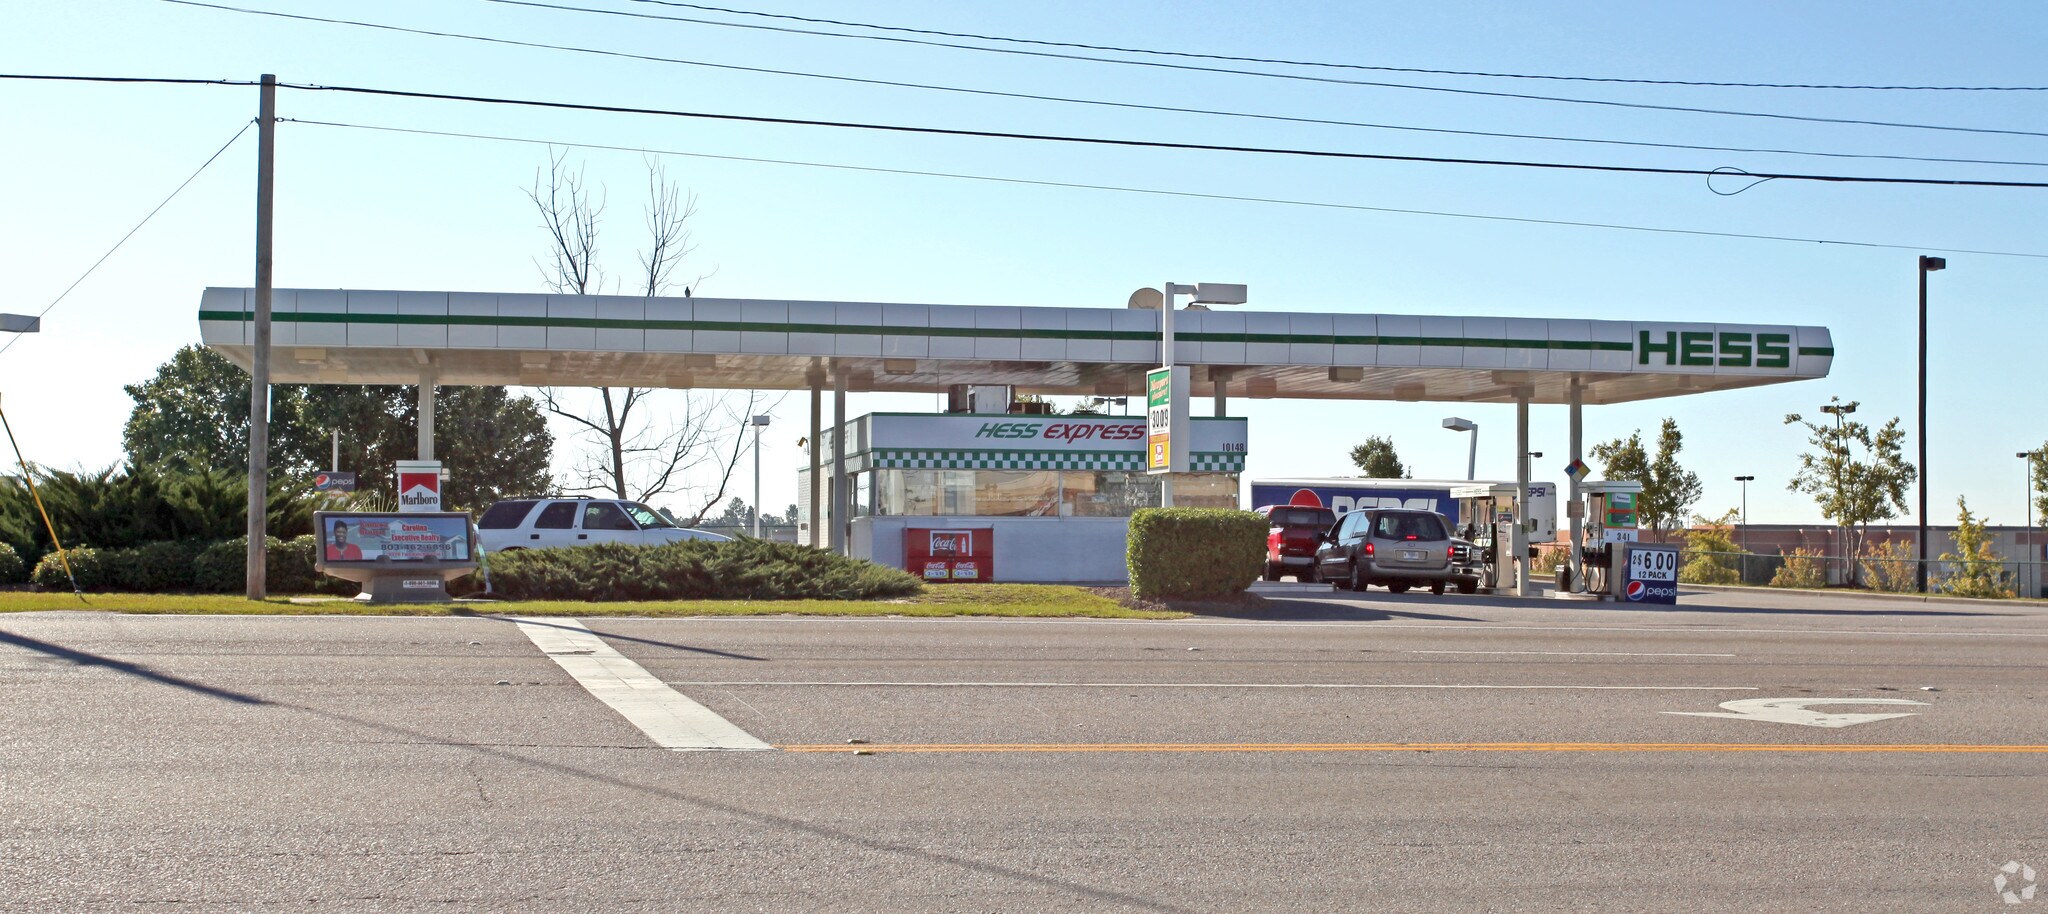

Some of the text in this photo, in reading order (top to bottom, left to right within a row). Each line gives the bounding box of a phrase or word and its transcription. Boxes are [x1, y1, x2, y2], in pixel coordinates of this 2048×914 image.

[1639, 330, 1790, 368] HESS
[975, 423, 1042, 439] HESS
[1222, 443, 1244, 452] 10148
[331, 477, 355, 486] pepsi
[1528, 487, 1546, 497] EPSI
[401, 492, 438, 505] Marlboro
[401, 523, 428, 532] Carolina
[391, 534, 440, 543] Executive Realty
[1638, 571, 1667, 579] 12 PACK
[1646, 586, 1676, 598] pepsi
